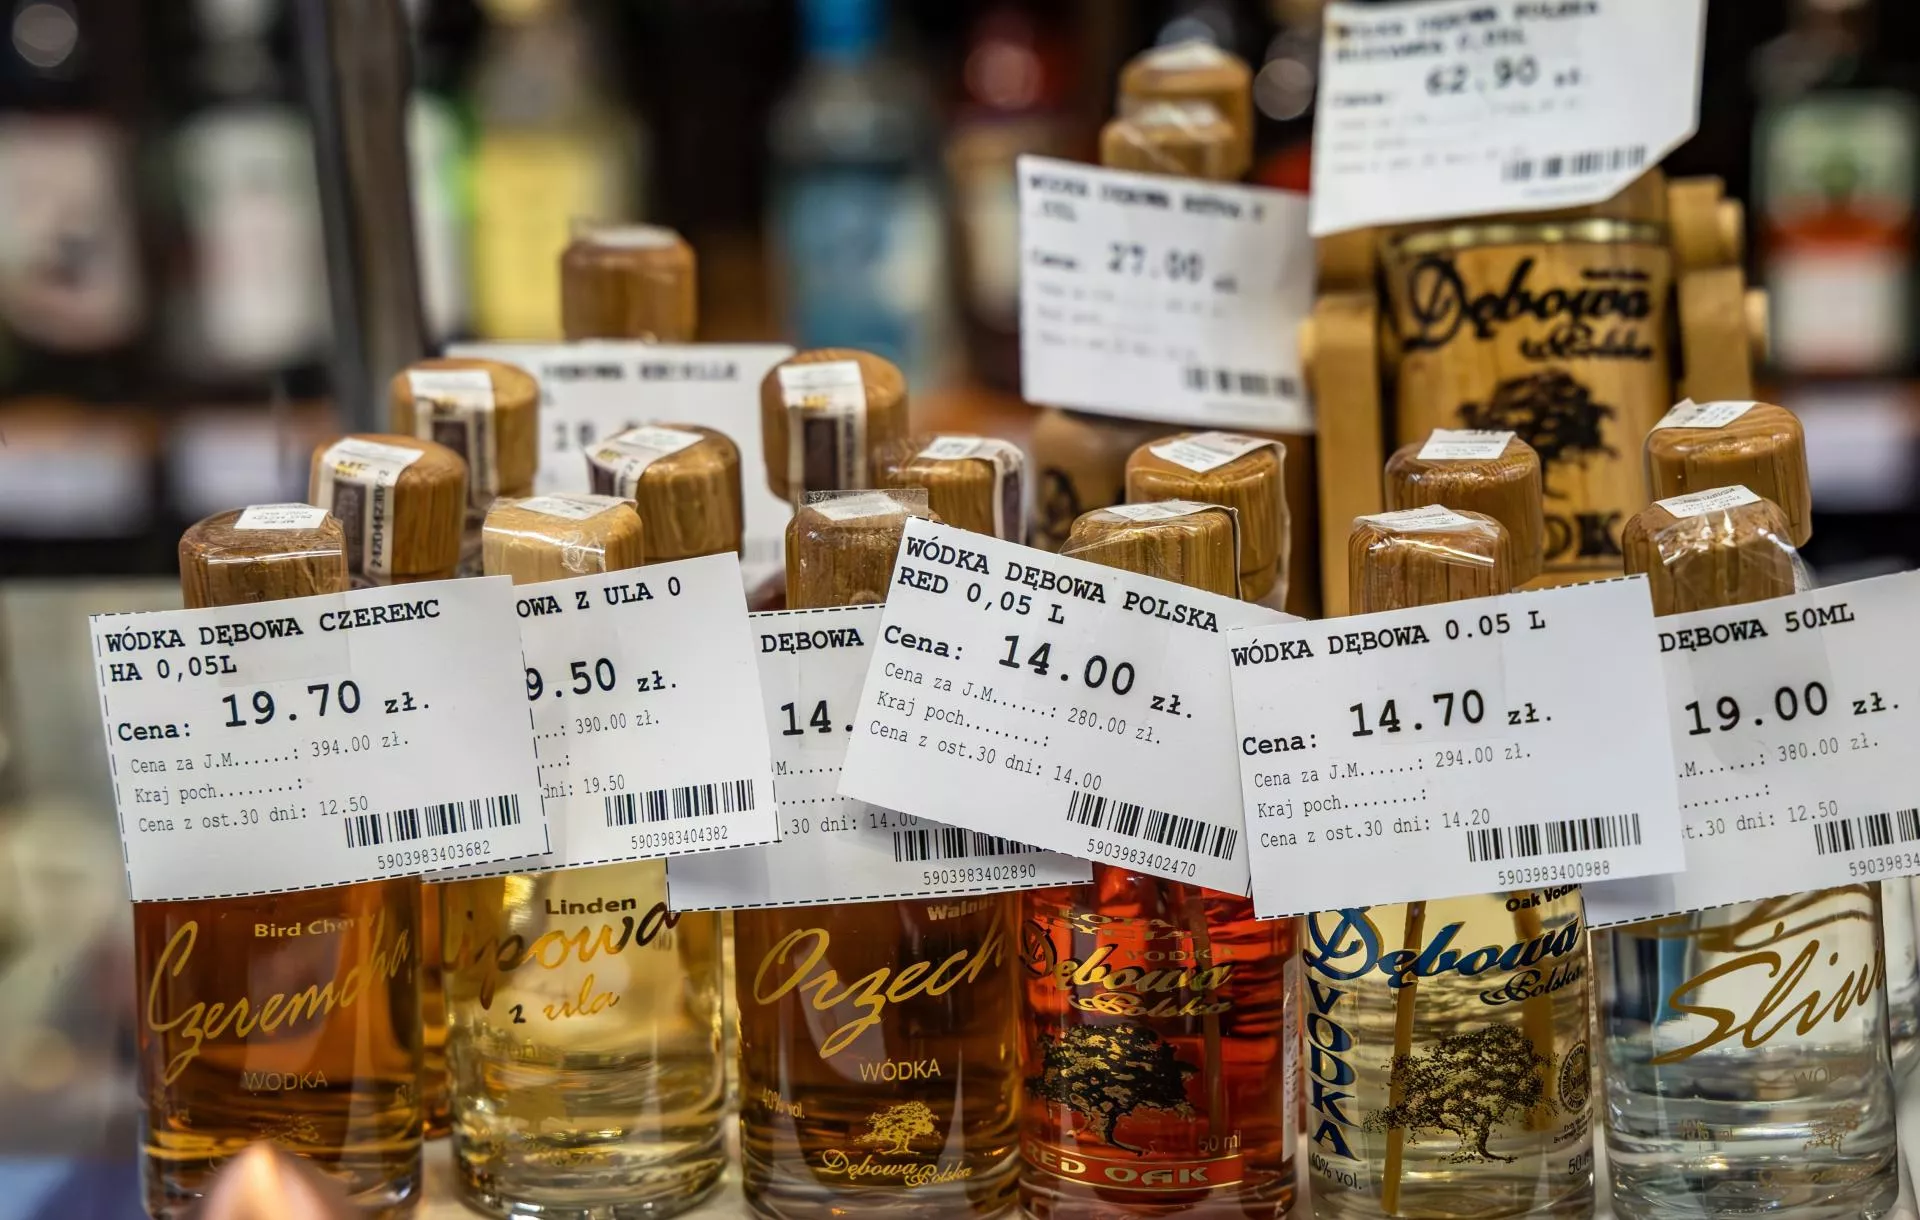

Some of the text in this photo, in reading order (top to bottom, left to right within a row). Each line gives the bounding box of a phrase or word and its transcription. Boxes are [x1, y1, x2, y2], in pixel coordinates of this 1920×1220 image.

[575, 590, 590, 610] Z
[603, 582, 654, 606] ULA
[667, 576, 681, 596] 0
[897, 567, 1065, 625] RED 0,05 L
[907, 536, 1219, 634] WÓDKA DĘBOWA POLSKA
[105, 599, 441, 653] WÓDKA DĘBOWA CZEREMC
[761, 628, 864, 655] DĘBOWA
[1231, 610, 1546, 667] WÓDKA DĘBOWA 0.05 L
[1659, 603, 1856, 653] DĘBOWA 50ML
[110, 655, 237, 683] HA 0,05L
[637, 670, 677, 693] zł.
[884, 625, 1193, 719] Cena: 14.00 zł.
[118, 680, 430, 742] Cena: 19.70 zł.
[877, 691, 915, 718] Kraj
[884, 662, 923, 686] Cena
[934, 675, 952, 693] za
[1067, 706, 1127, 737] 280.00
[1685, 681, 1899, 736] 19.00 zł.
[575, 711, 626, 735] 390.00
[1242, 689, 1552, 757] Cena: 14.70 zł.
[130, 757, 166, 775] Cena
[176, 756, 194, 772] za
[311, 735, 371, 758] 394.00
[870, 719, 908, 743] Cena
[918, 733, 927, 748] z
[1005, 752, 1042, 777] dni:
[1053, 765, 1102, 791] 14.00
[1778, 736, 1839, 763] 380.00
[1254, 771, 1291, 789] Cena
[1301, 769, 1319, 784] za
[1435, 744, 1494, 769] 294.00
[135, 786, 169, 807] Kraj
[584, 773, 625, 794] 19.50
[138, 815, 174, 833] Cena
[184, 816, 193, 830] z
[269, 803, 308, 823] dni:
[319, 795, 369, 817] 12.50
[821, 814, 857, 833] dni:
[870, 812, 918, 829] 14.00
[1257, 800, 1293, 820] Kraj
[1736, 808, 1776, 833] dni:
[1787, 800, 1840, 825] 12.50
[631, 825, 728, 850] 5903983404382
[1260, 830, 1298, 849] Cena
[1307, 830, 1316, 844] z
[1393, 815, 1431, 835] dni:
[1442, 807, 1491, 829] 14.20
[377, 840, 491, 871] 5903983403682
[1086, 837, 1197, 878] 5903983402470
[923, 863, 1036, 886] 5903983402890
[1498, 860, 1610, 886] 5903983400988
[545, 897, 637, 916] Linden
[1505, 893, 1541, 912] Oak
[254, 922, 301, 938] Bird
[543, 973, 620, 1021] ula
[754, 904, 1004, 1059] Orzech
[1480, 966, 1586, 1006] Polska
[859, 1058, 941, 1083] WÓDKA
[1305, 975, 1362, 1162] VODKA
[788, 1102, 806, 1120] vol.
[815, 1148, 917, 1181] Dębowa
[1104, 1166, 1209, 1185] OAK
[1335, 1168, 1362, 1191] vol.
